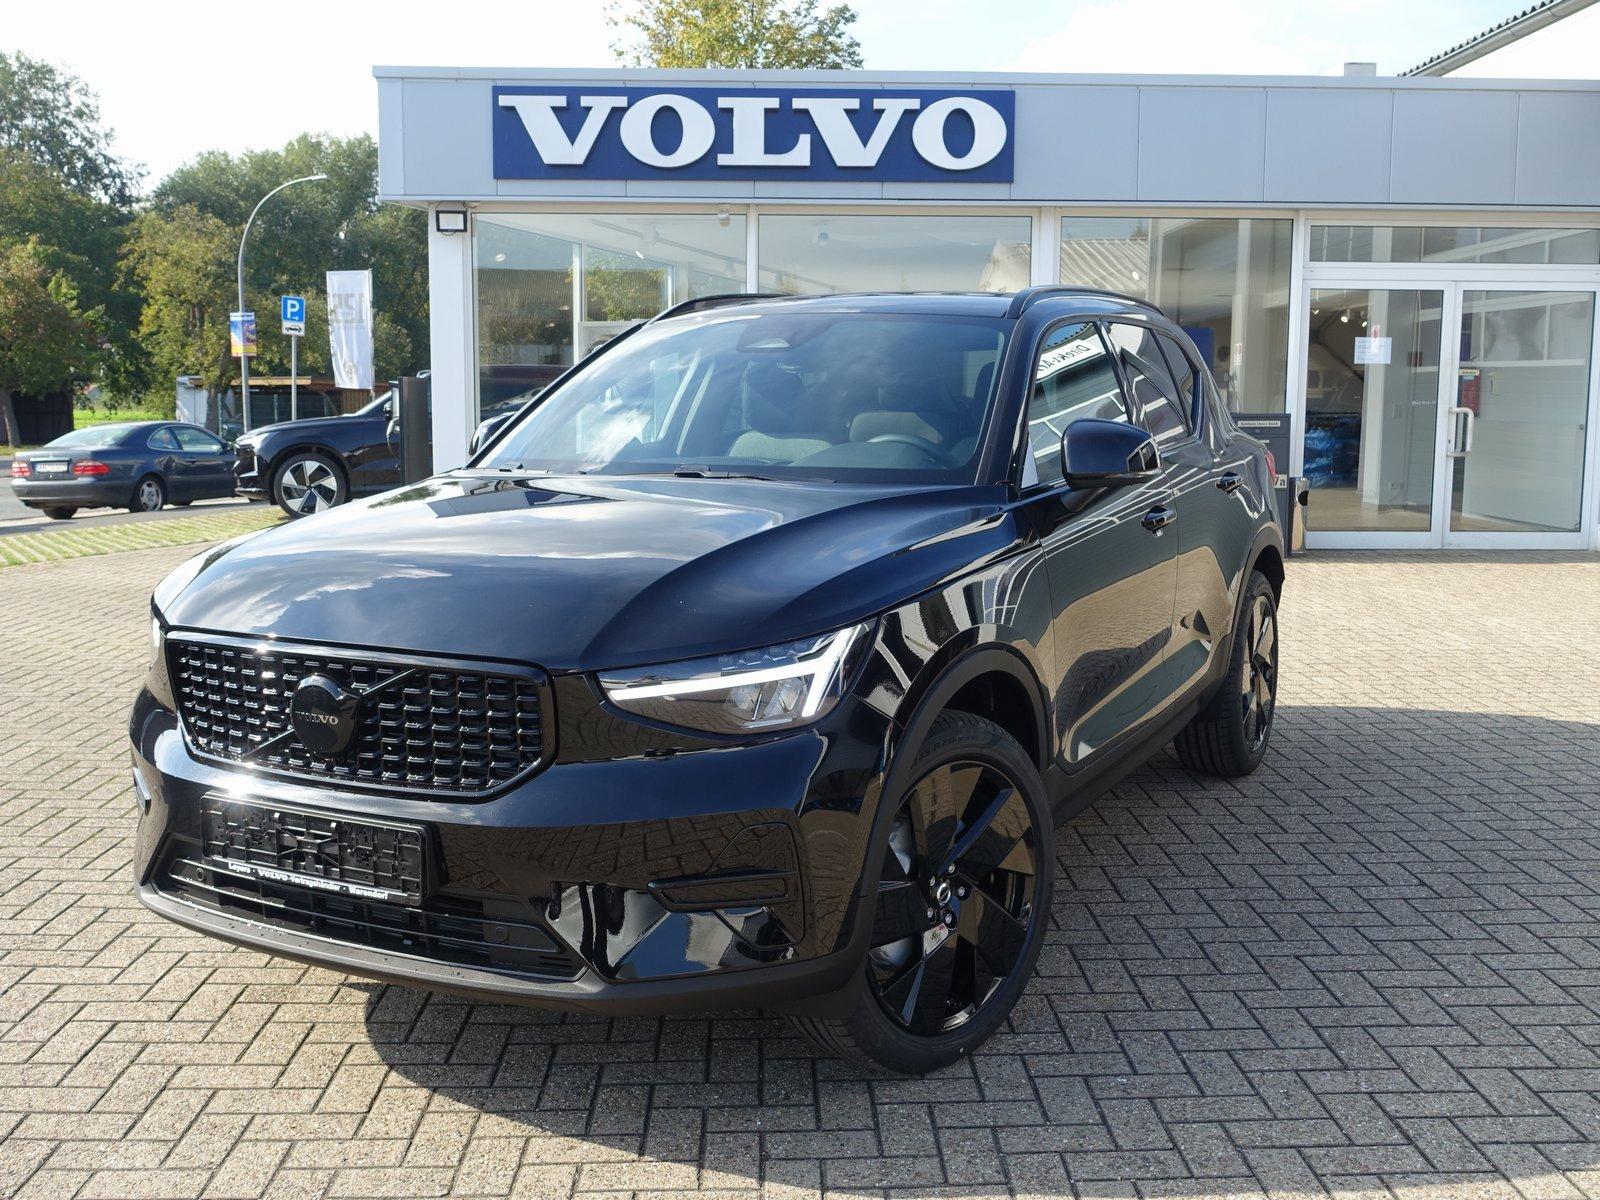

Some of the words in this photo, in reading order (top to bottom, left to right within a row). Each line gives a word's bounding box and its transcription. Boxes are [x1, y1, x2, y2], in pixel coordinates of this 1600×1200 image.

[498, 94, 1007, 170] VOLVO
[287, 299, 300, 319] P
[295, 710, 339, 725] OLVO
[349, 885, 389, 900] Warendorf
